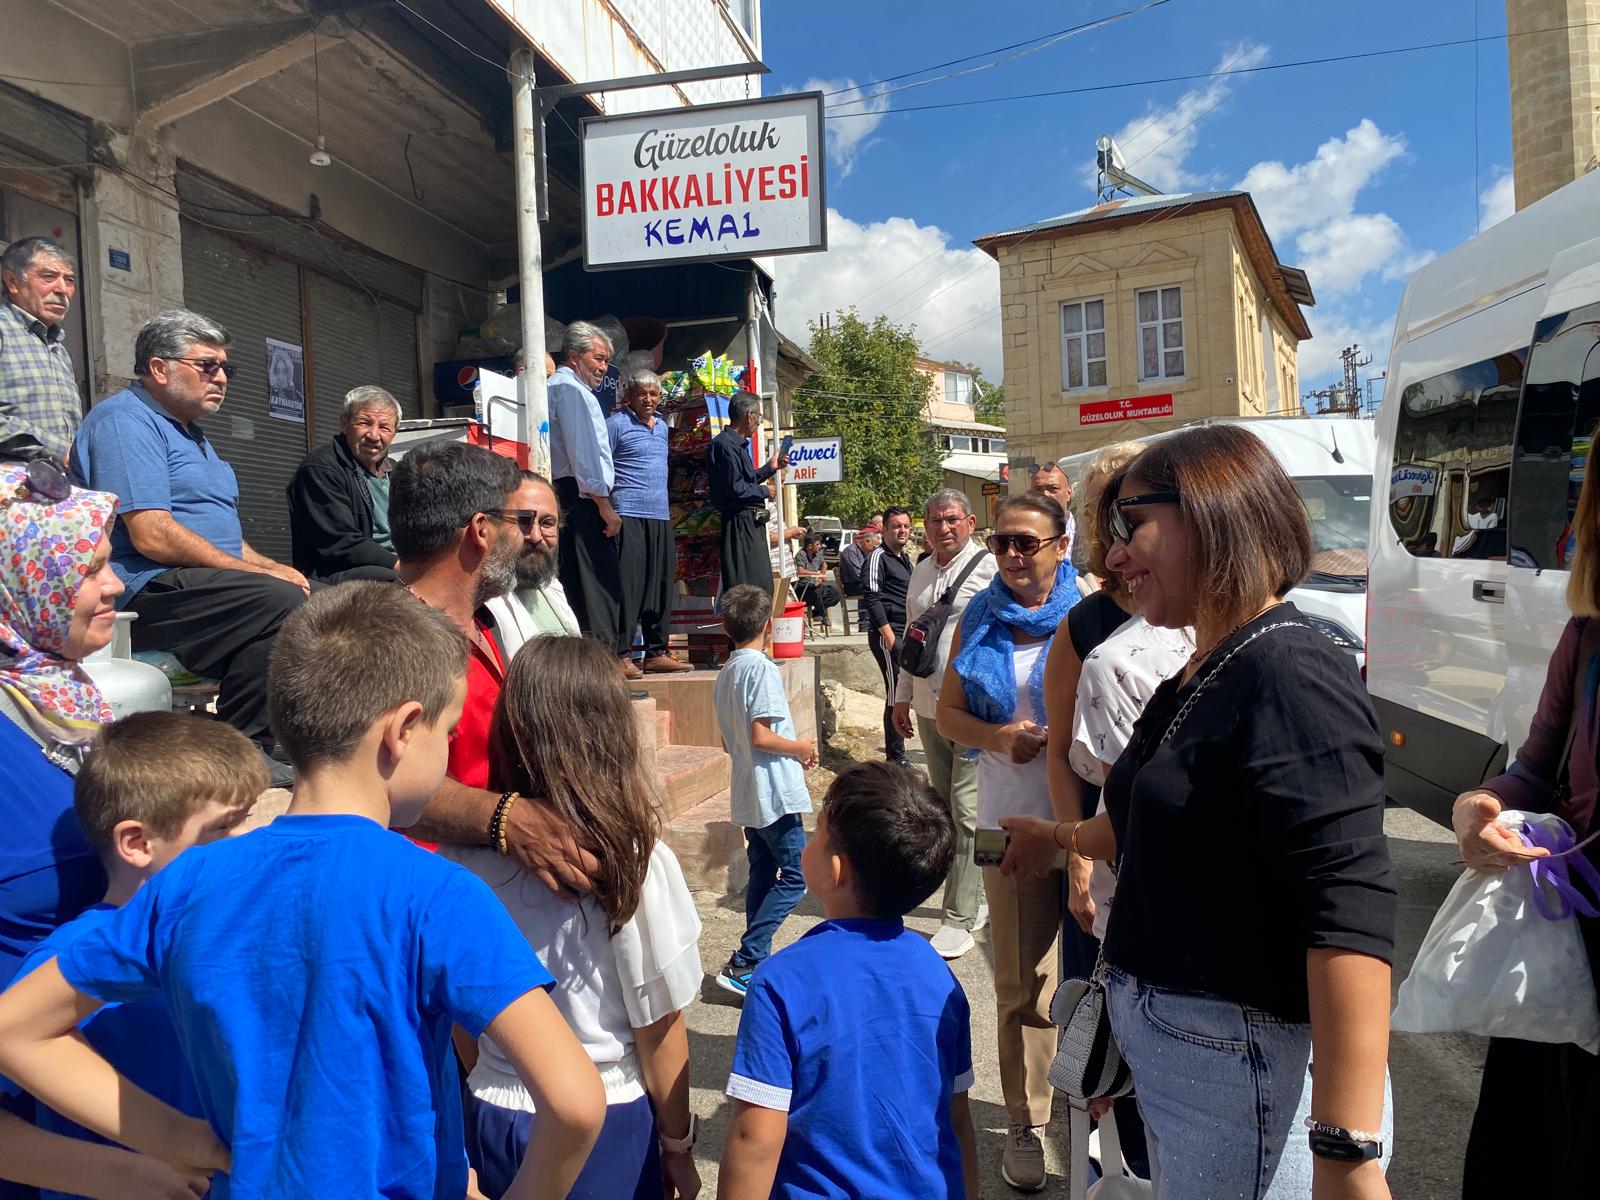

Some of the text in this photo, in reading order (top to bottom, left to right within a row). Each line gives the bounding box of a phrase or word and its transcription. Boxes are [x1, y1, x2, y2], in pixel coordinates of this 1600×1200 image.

[633, 121, 781, 171] Güzeloluk
[596, 154, 809, 217] BAKKALİYESİ
[643, 211, 760, 247] KEMAL
[1081, 404, 1172, 422] GÜZELOLUK MUHTARLIĞI
[1119, 400, 1133, 408] T.C.
[789, 443, 838, 467] ahveci
[793, 466, 817, 480] ARİF
[1317, 1123, 1341, 1137] AYFER
